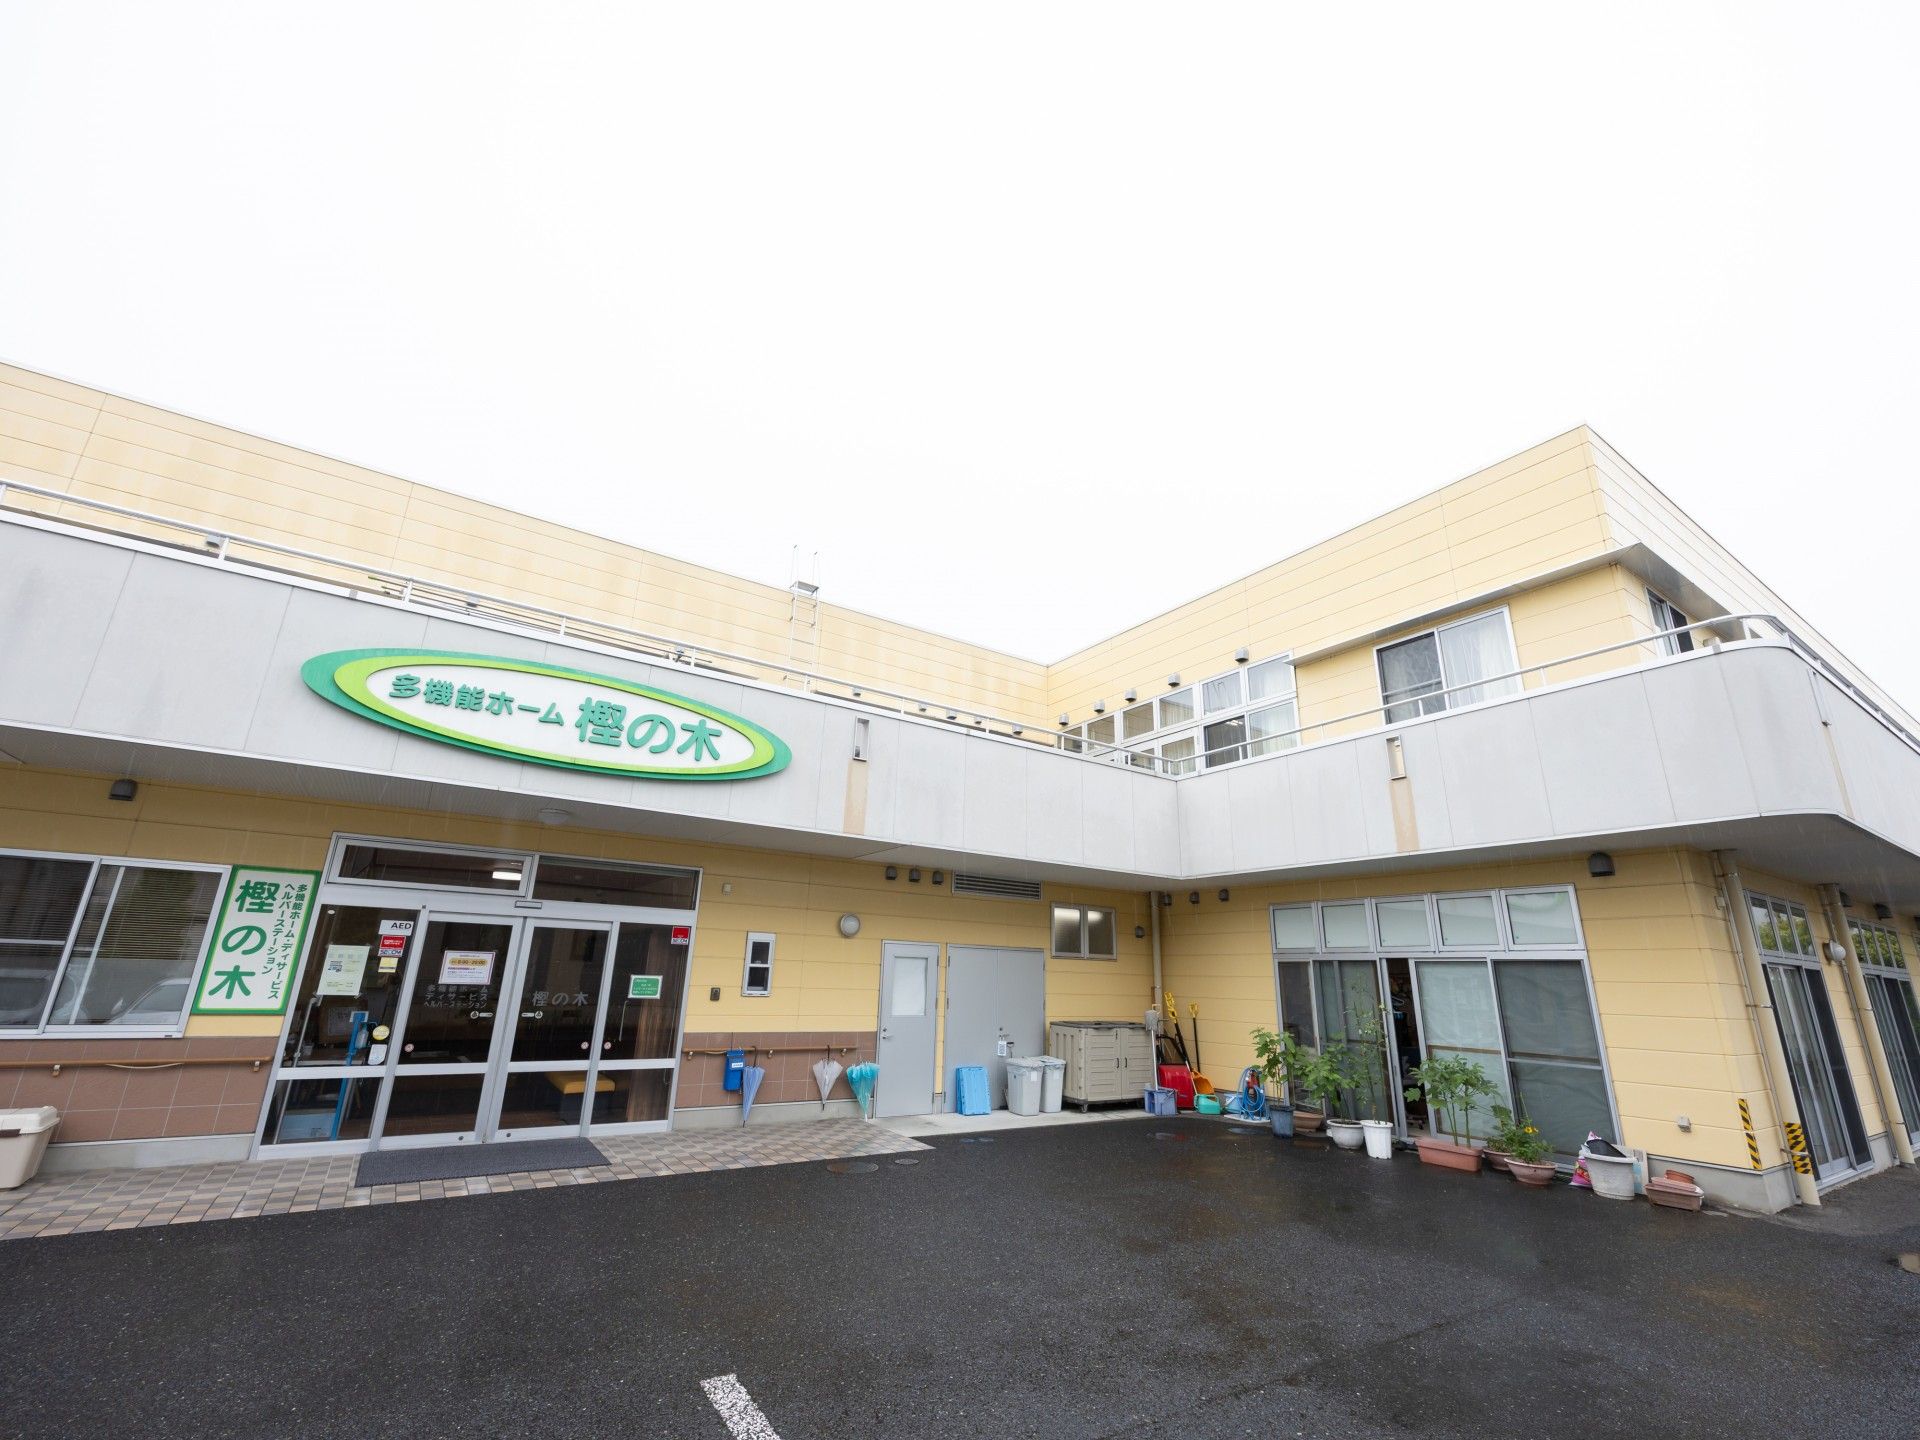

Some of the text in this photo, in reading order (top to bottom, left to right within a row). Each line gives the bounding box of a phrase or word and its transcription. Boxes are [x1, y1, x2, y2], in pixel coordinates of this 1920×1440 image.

[388, 673, 723, 762] 多機能ホーム 樫の木
[208, 879, 281, 1000] 樫の木
[391, 922, 412, 930] AED
